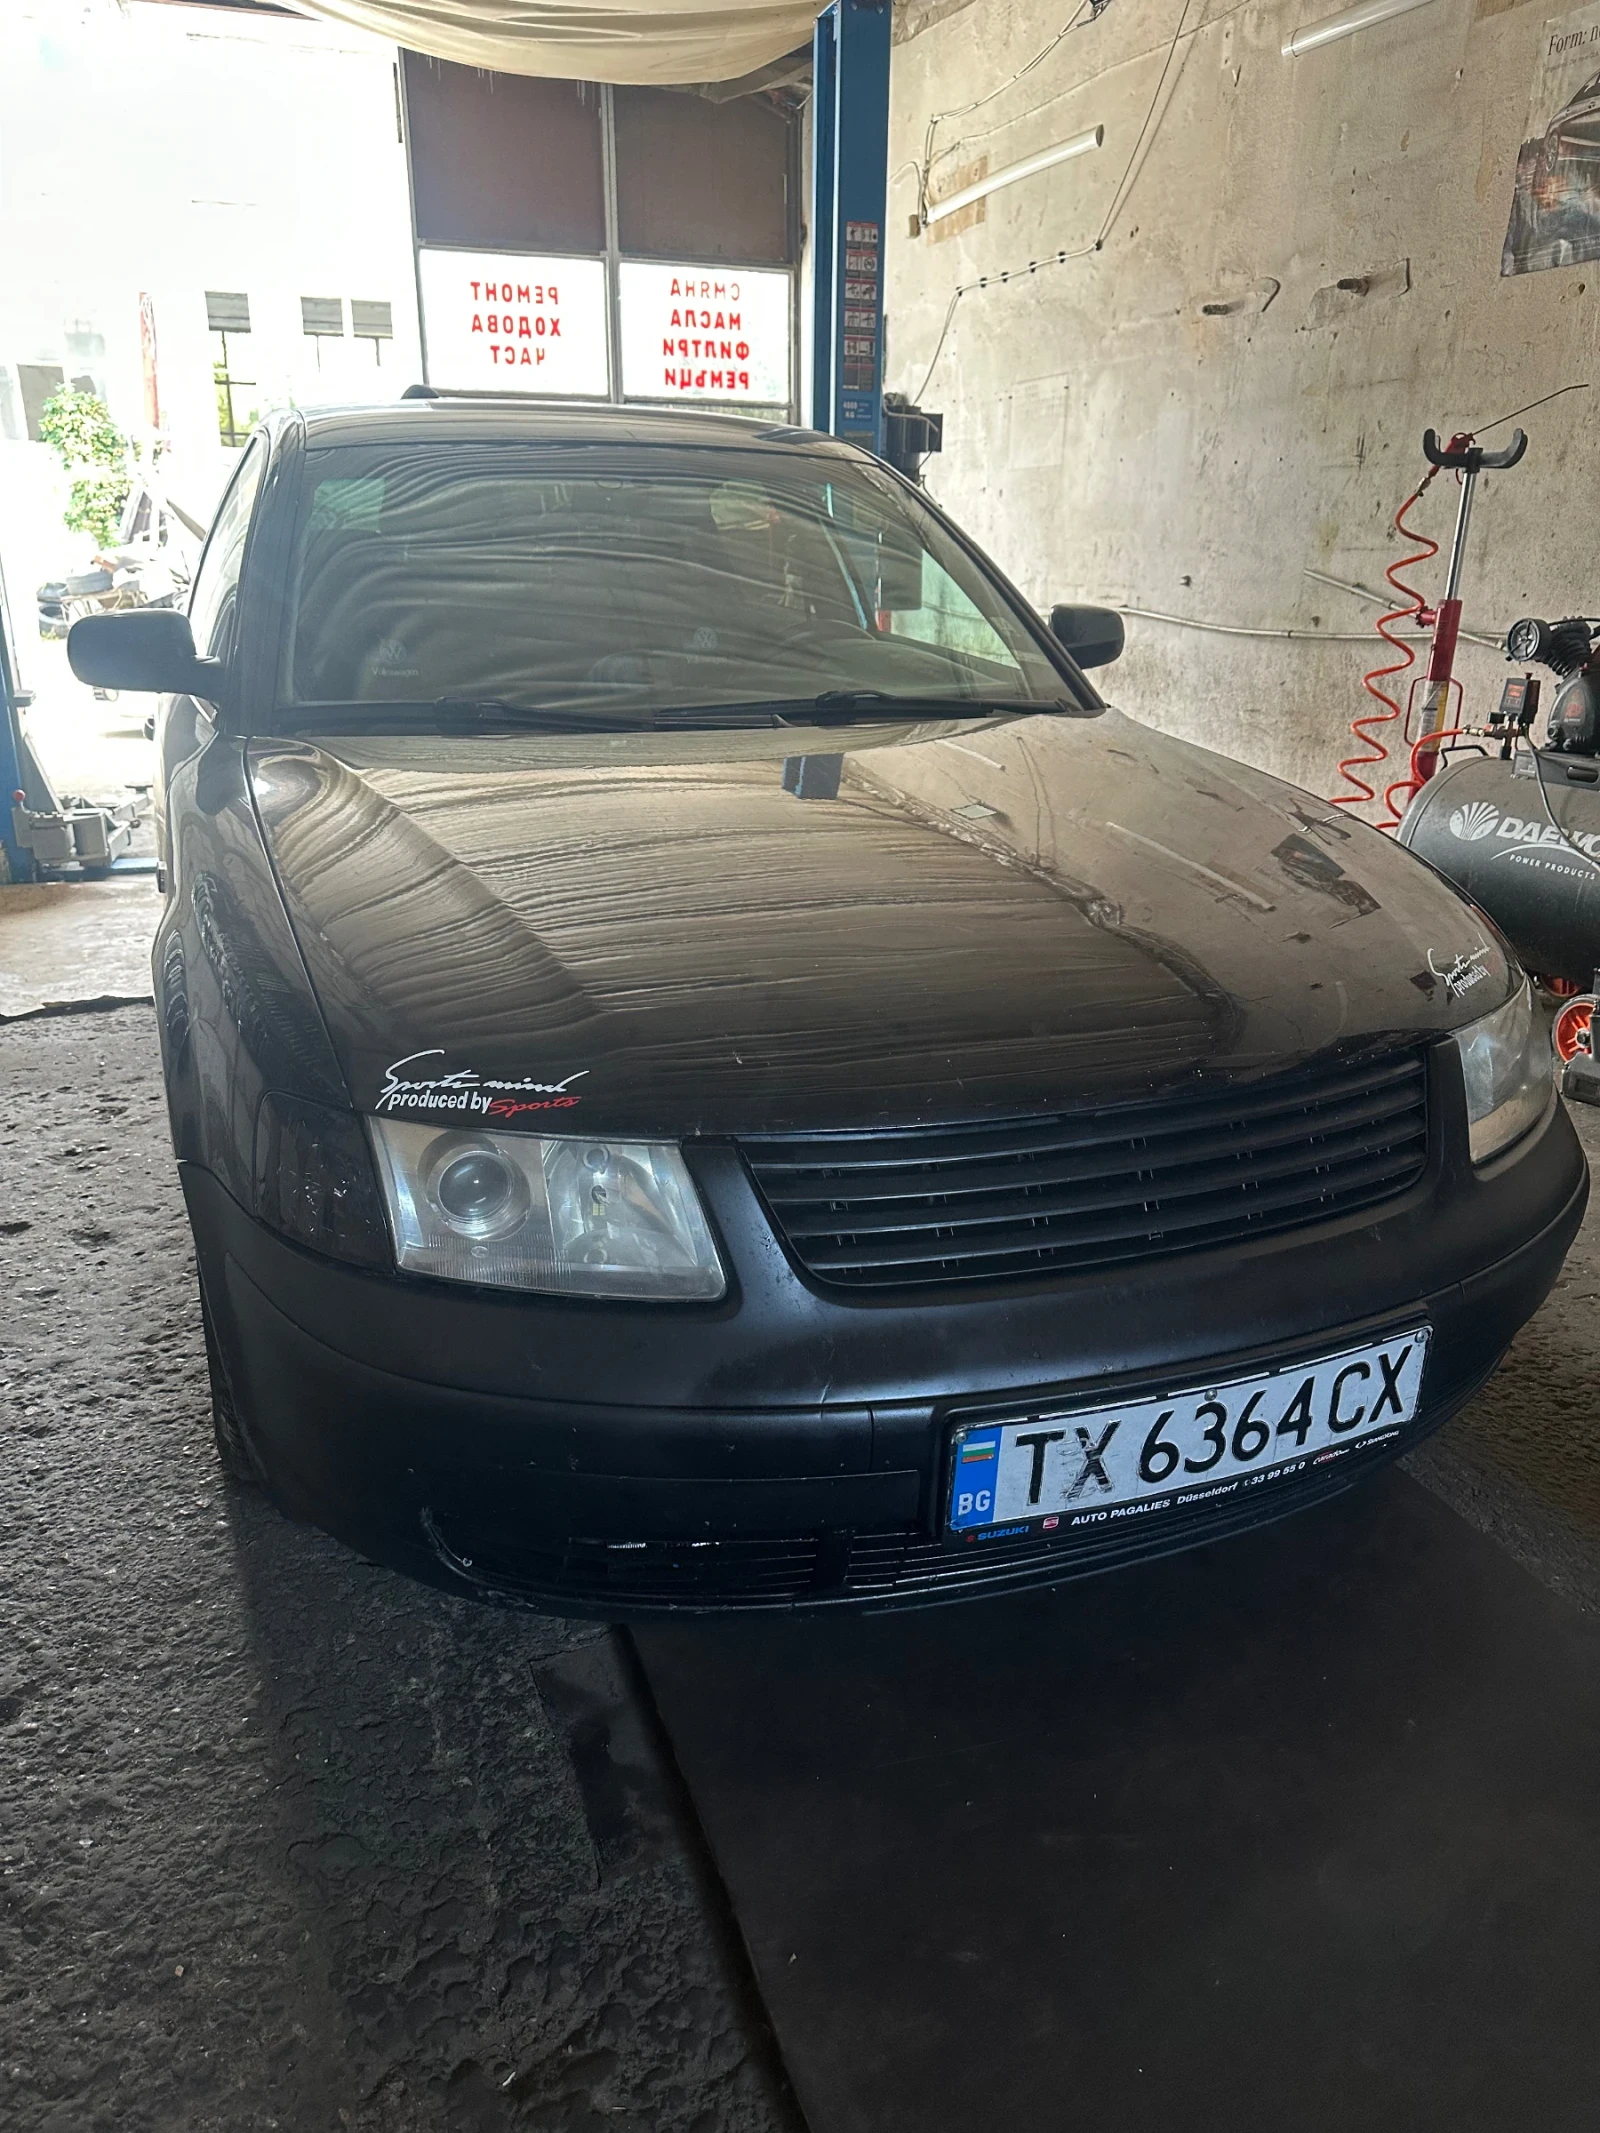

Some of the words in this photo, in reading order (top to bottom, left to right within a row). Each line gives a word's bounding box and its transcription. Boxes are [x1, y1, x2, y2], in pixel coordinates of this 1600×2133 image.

[1548, 31, 1587, 56] Form:
[1510, 854, 1541, 867] POWER
[1545, 862, 1596, 880] PRODUCTS
[388, 1089, 469, 1111] produced
[470, 1091, 492, 1114] by
[488, 1096, 582, 1118] Sports
[1014, 1419, 1122, 1506] TX
[957, 1490, 991, 1516] BG
[1070, 1511, 1107, 1527] AUTO
[1109, 1498, 1171, 1519] PAGALIES
[1176, 1481, 1239, 1505] Düsseldorf
[1250, 1474, 1265, 1485] 33
[1267, 1468, 1281, 1479] 99
[1282, 1464, 1297, 1475] 55
[1297, 1461, 1306, 1471] 0
[977, 1525, 1030, 1541] SUZUKI
